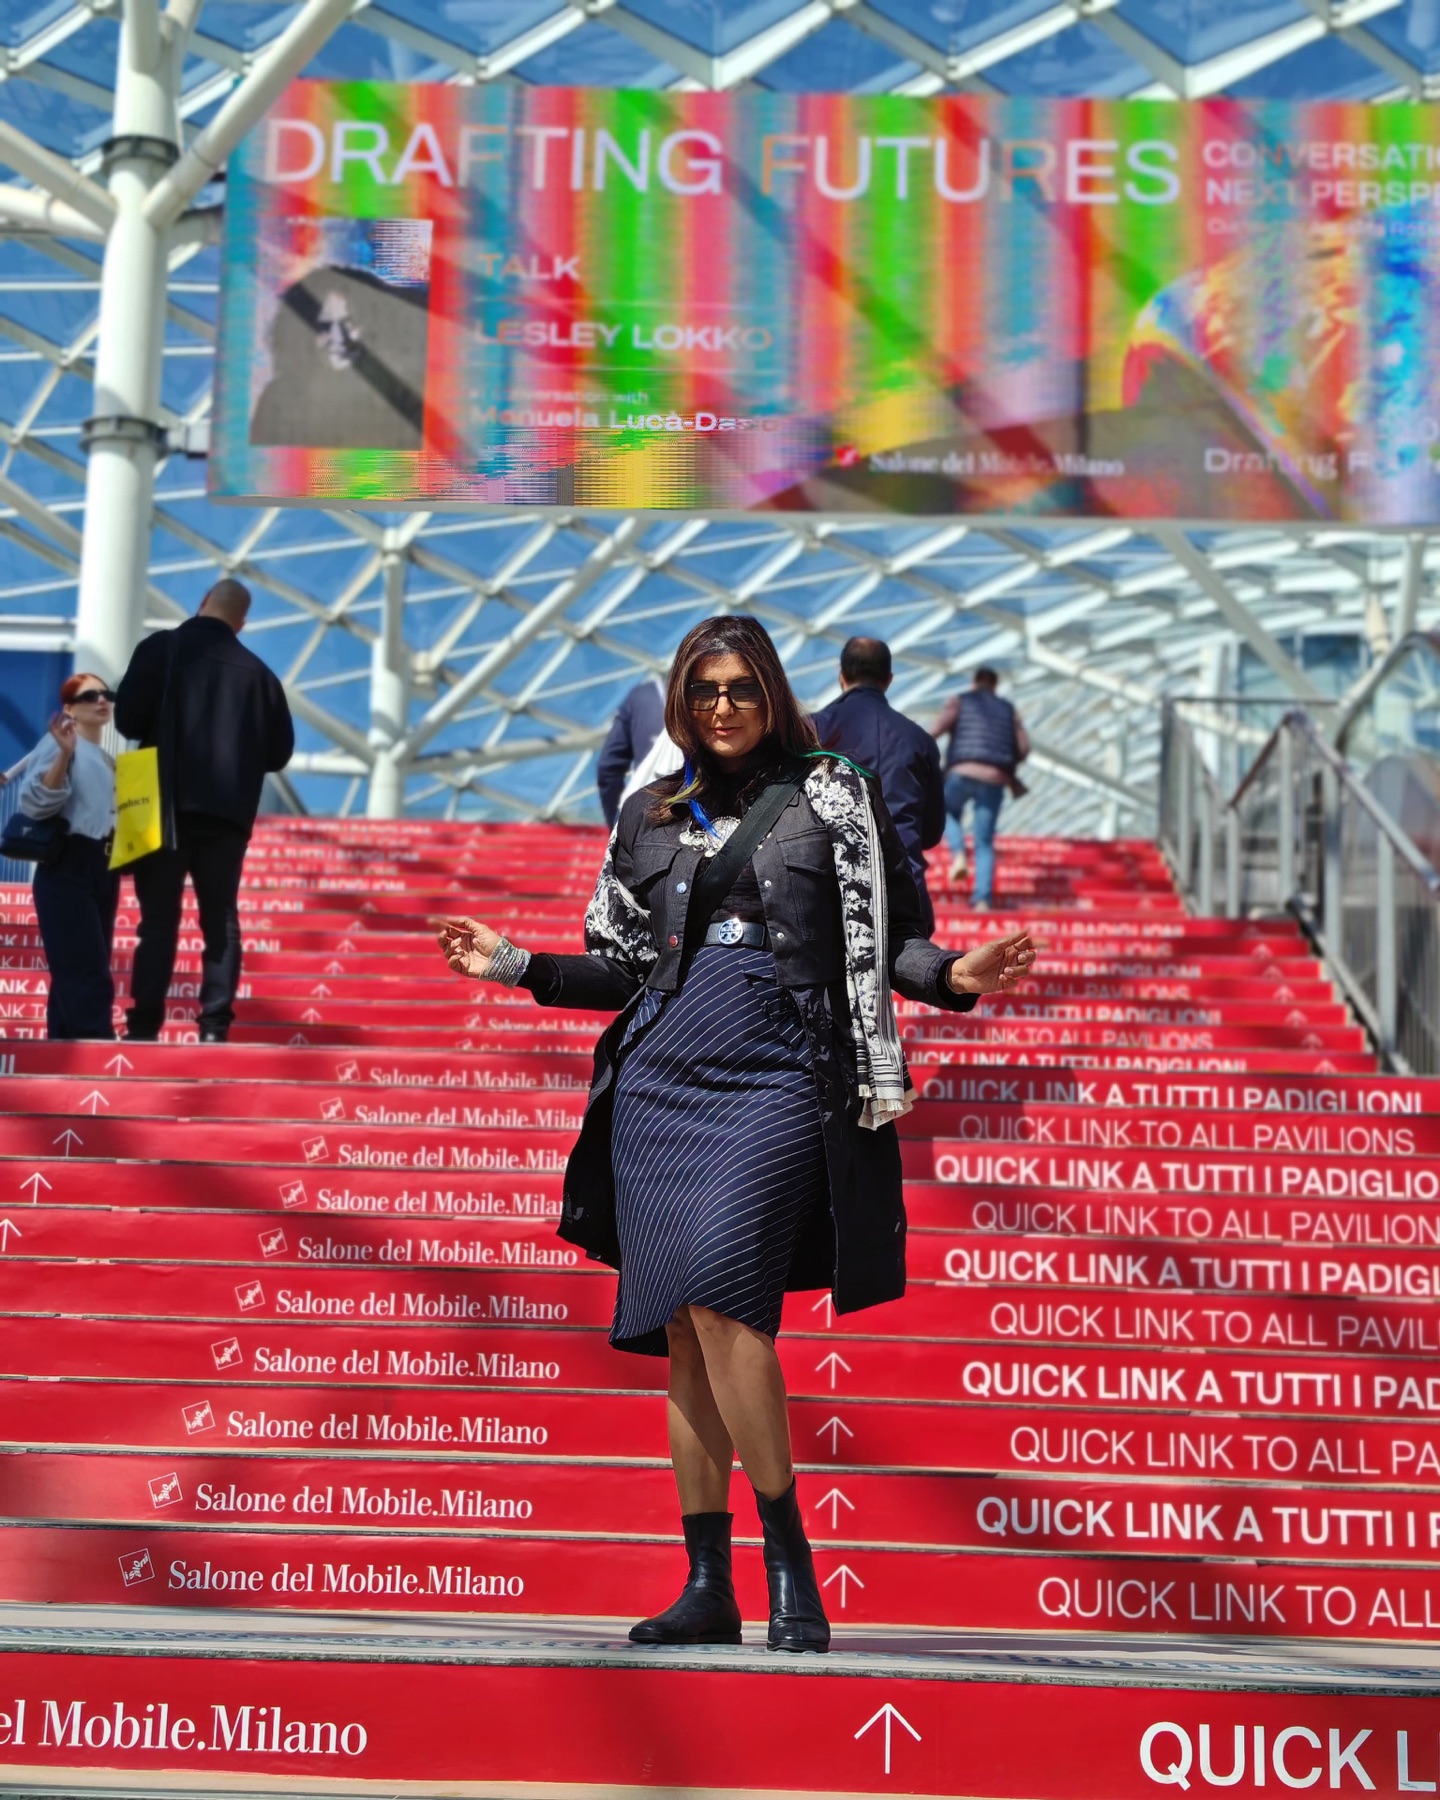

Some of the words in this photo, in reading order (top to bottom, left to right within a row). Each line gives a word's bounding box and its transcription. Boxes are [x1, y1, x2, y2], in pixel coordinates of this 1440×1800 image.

[265, 118, 723, 195] DRAFTING
[761, 133, 1182, 205] FUTURES
[1202, 139, 1440, 171] CONVERSATI
[480, 254, 581, 281] TALK
[474, 319, 622, 348] LESLEY
[632, 324, 773, 351] LOKKO
[369, 1067, 433, 1086] Salone
[439, 1069, 467, 1087] del
[922, 1078, 1019, 1101] QUICK
[1028, 1081, 1097, 1105] LINK
[1105, 1083, 1126, 1107] A
[1131, 1083, 1219, 1109] TUTTI
[1227, 1087, 1235, 1110] I
[1244, 1086, 1422, 1114] PADIGLIONI
[355, 1105, 422, 1123] Salone
[426, 1107, 457, 1125] del
[462, 1107, 583, 1128] Mobile.Mila
[960, 1115, 1056, 1142] QUICK
[1064, 1119, 1132, 1146] LINK
[1139, 1120, 1182, 1148] TO
[1189, 1122, 1247, 1150] ALL
[1253, 1124, 1416, 1155] PAVILIONS
[338, 1143, 408, 1166] Salone
[412, 1146, 444, 1167] del
[449, 1147, 569, 1170] Mobile.Mila
[935, 1154, 1041, 1186] QUICK
[1050, 1158, 1125, 1189] LINK
[1134, 1162, 1158, 1191] A
[1162, 1162, 1255, 1195] TUTTI
[1265, 1166, 1273, 1194] I
[1281, 1166, 1439, 1199] PADIGLIO
[316, 1188, 389, 1212] Salone
[394, 1191, 428, 1213] del
[433, 1191, 563, 1216] Mobile.Mila
[972, 1202, 1076, 1233] QUICK
[1086, 1206, 1159, 1237] LINK
[1167, 1208, 1213, 1239] TO
[1221, 1210, 1282, 1241] ALL
[1290, 1211, 1440, 1244] PAVILION
[297, 1237, 374, 1261] Salone
[379, 1239, 413, 1262] del
[418, 1240, 578, 1267] Mobile.Milano
[944, 1248, 1060, 1282] QUICK
[1068, 1252, 1149, 1286] LINK
[1157, 1257, 1183, 1287] A
[1190, 1257, 1291, 1291] TUTTI
[1301, 1261, 1309, 1291] I
[275, 1290, 355, 1316] Salone
[360, 1292, 396, 1317] del
[402, 1293, 569, 1320] Mobile.Milano
[990, 1303, 1104, 1337] QUICK
[1115, 1307, 1195, 1341] LINK
[1202, 1311, 1253, 1343] TO
[1261, 1313, 1328, 1347] ALL
[1337, 1315, 1440, 1350] PAVIL
[254, 1347, 337, 1374] Salone
[342, 1350, 380, 1375] del
[386, 1351, 560, 1380] Mobile.Milano
[962, 1361, 1087, 1398] QUICK
[1098, 1366, 1187, 1402] LINK
[1195, 1369, 1223, 1402] A
[1231, 1370, 1342, 1407] TUTTI
[1353, 1374, 1361, 1407] I
[227, 1410, 314, 1438] Salone
[320, 1414, 359, 1440] del
[366, 1414, 549, 1445] Mobile.Milano
[1010, 1426, 1135, 1464] QUICK
[1146, 1432, 1234, 1470] LINK
[1242, 1435, 1298, 1472] TO
[1308, 1438, 1381, 1475] ALL
[1391, 1440, 1440, 1477] PA
[195, 1483, 286, 1512] Salone
[292, 1486, 334, 1514] del
[339, 1487, 534, 1519] Mobile.Milano
[976, 1496, 1114, 1537] QUICK
[1126, 1502, 1224, 1541] LINK
[1233, 1506, 1264, 1542] A
[1272, 1507, 1393, 1546] TUTTI
[1407, 1511, 1416, 1547] I
[168, 1560, 264, 1591] Salone
[270, 1563, 314, 1593] del
[320, 1564, 525, 1597] Mobile.Milano
[1038, 1577, 1176, 1618] QUICK
[1190, 1582, 1286, 1623] LINK
[1296, 1585, 1357, 1625] TO
[1368, 1588, 1440, 1628] ALL
[38, 1699, 368, 1755] Mobile.Milano
[1139, 1721, 1377, 1791] QUICK
[1396, 1730, 1440, 1792] L
